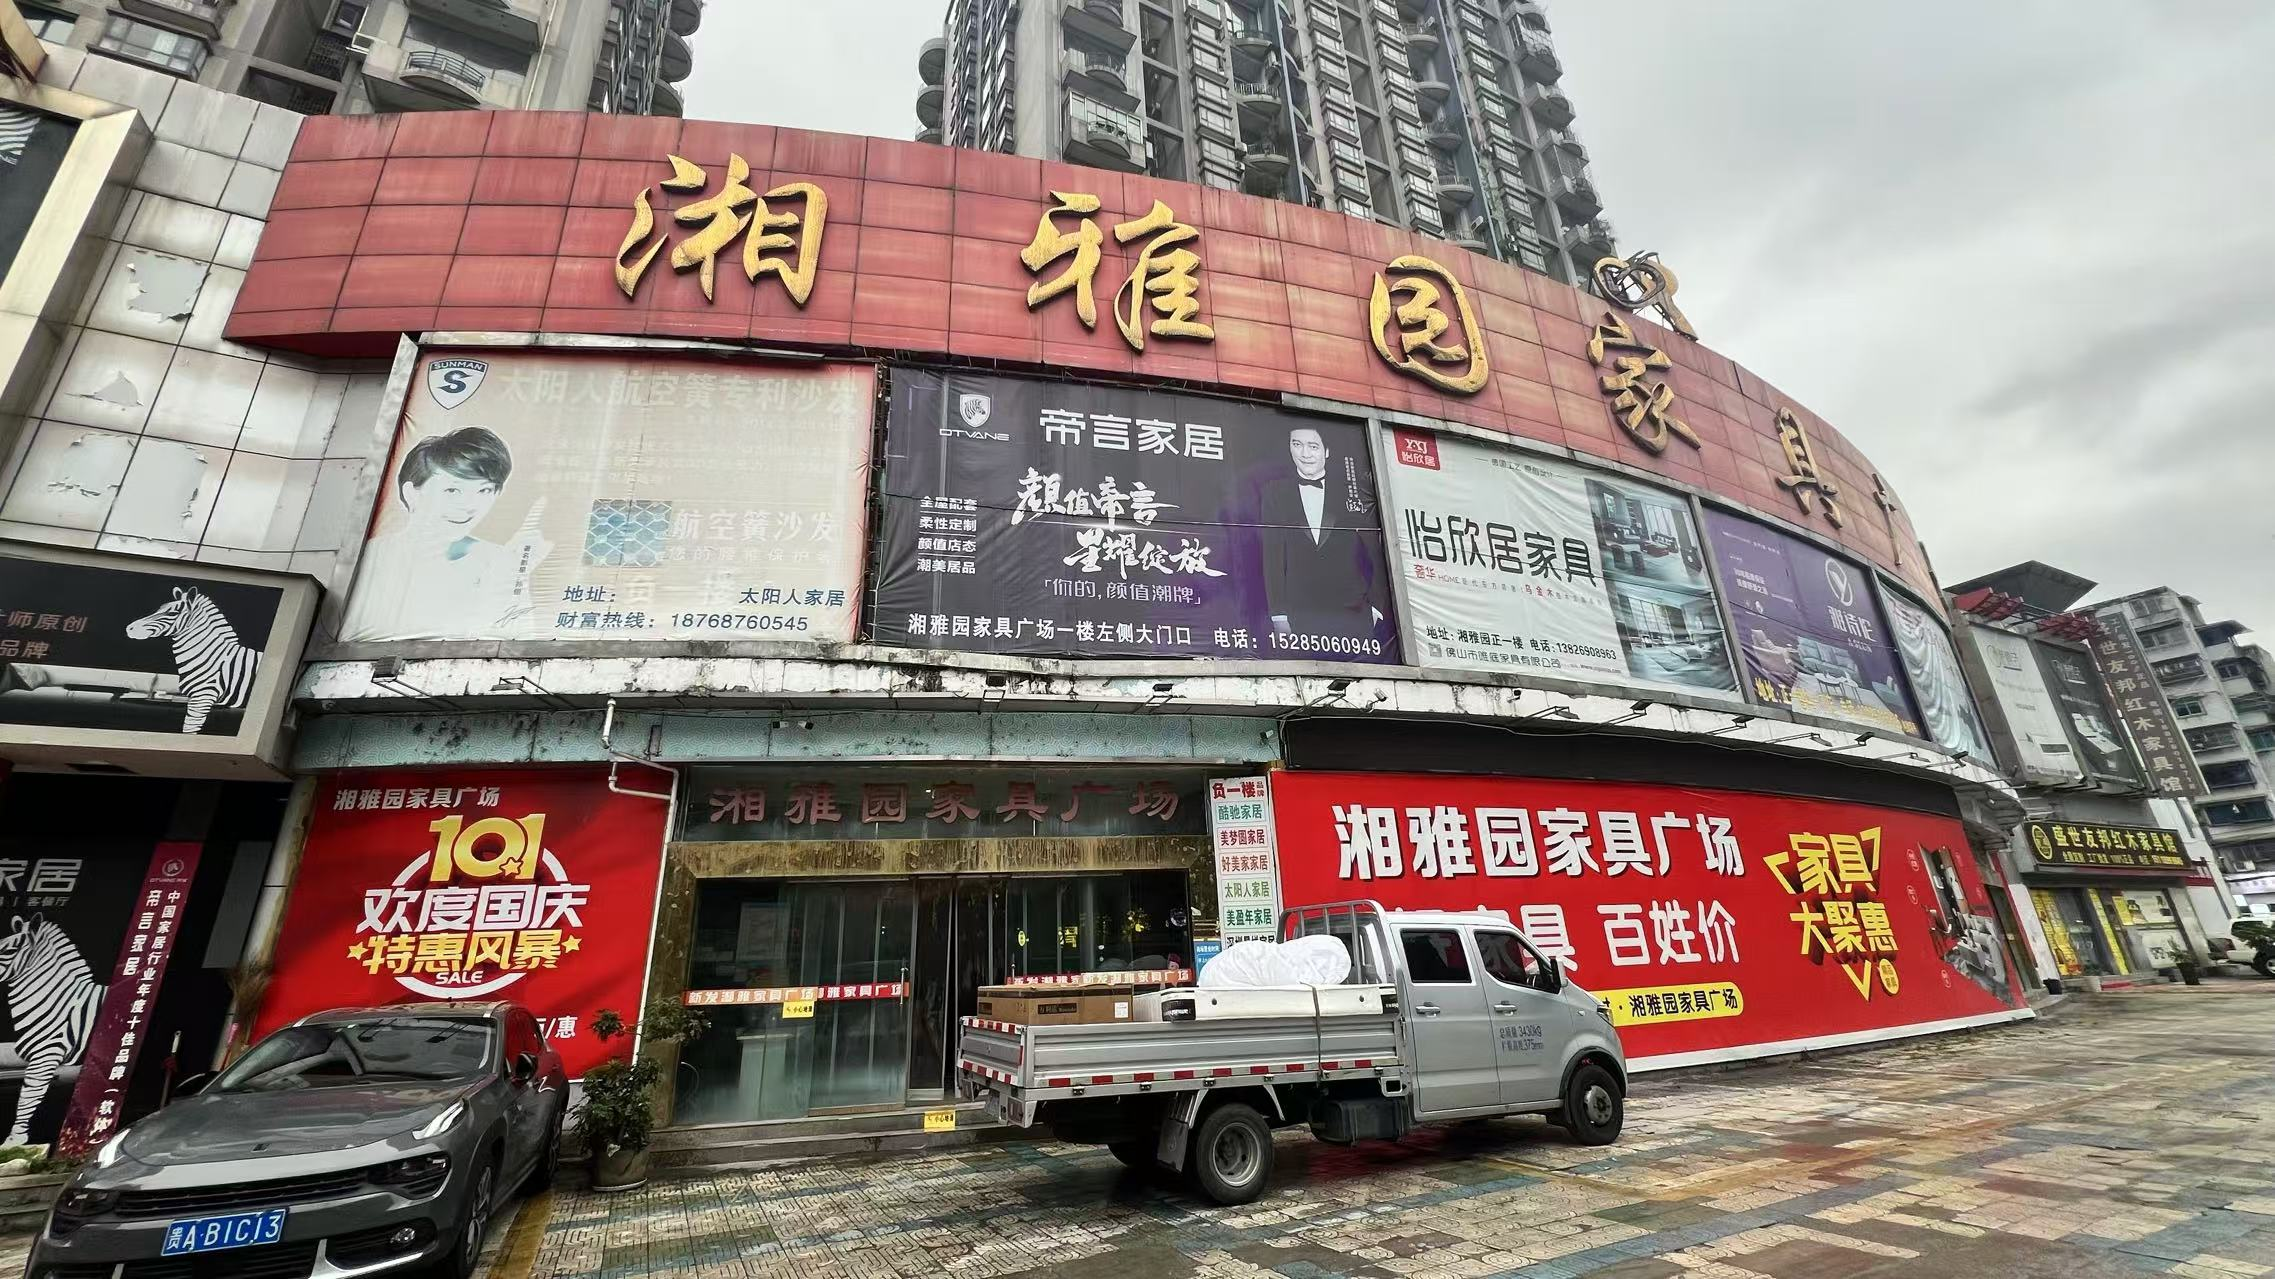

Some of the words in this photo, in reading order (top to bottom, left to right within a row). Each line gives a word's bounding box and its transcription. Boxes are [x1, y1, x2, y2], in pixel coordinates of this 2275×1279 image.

[433, 360, 483, 371] SUNMAN
[939, 428, 1010, 441] DTVANE
[1039, 408, 1224, 461] 帝言家居
[1401, 451, 1436, 467] 怡欣居
[919, 496, 977, 512] 全屋配套
[918, 516, 977, 533] 柔性定制
[917, 537, 977, 554] 颜值店态
[1405, 508, 1596, 587] 怡欣居家具
[916, 557, 976, 575] 潮美居品
[739, 587, 846, 607] 太阳人家居
[0, 608, 88, 633] 师原创
[908, 613, 1191, 646] 湘雅园家具广场一楼左侧大门口
[0, 640, 50, 659] 品牌
[333, 786, 501, 810] 湘雅园家具广场
[1212, 781, 1257, 799] 负一楼
[709, 779, 1181, 825] 湘雅园家具广场
[1218, 803, 1263, 820] 酷驰家居
[429, 813, 546, 881] 101
[1332, 804, 1745, 879] 湘雅园家具广场
[1222, 854, 1268, 872] 好美家家居
[1789, 831, 1877, 894] 家具
[1224, 881, 1270, 898] 太阳人家居
[355, 883, 591, 934] 欢度国庆
[1597, 899, 1740, 966] 百姓价
[1789, 901, 1899, 955] 大聚惠
[362, 929, 563, 974] 特惠风暴
[435, 971, 483, 985] SALE
[1629, 988, 1738, 1018] 湘雅园家具广场
